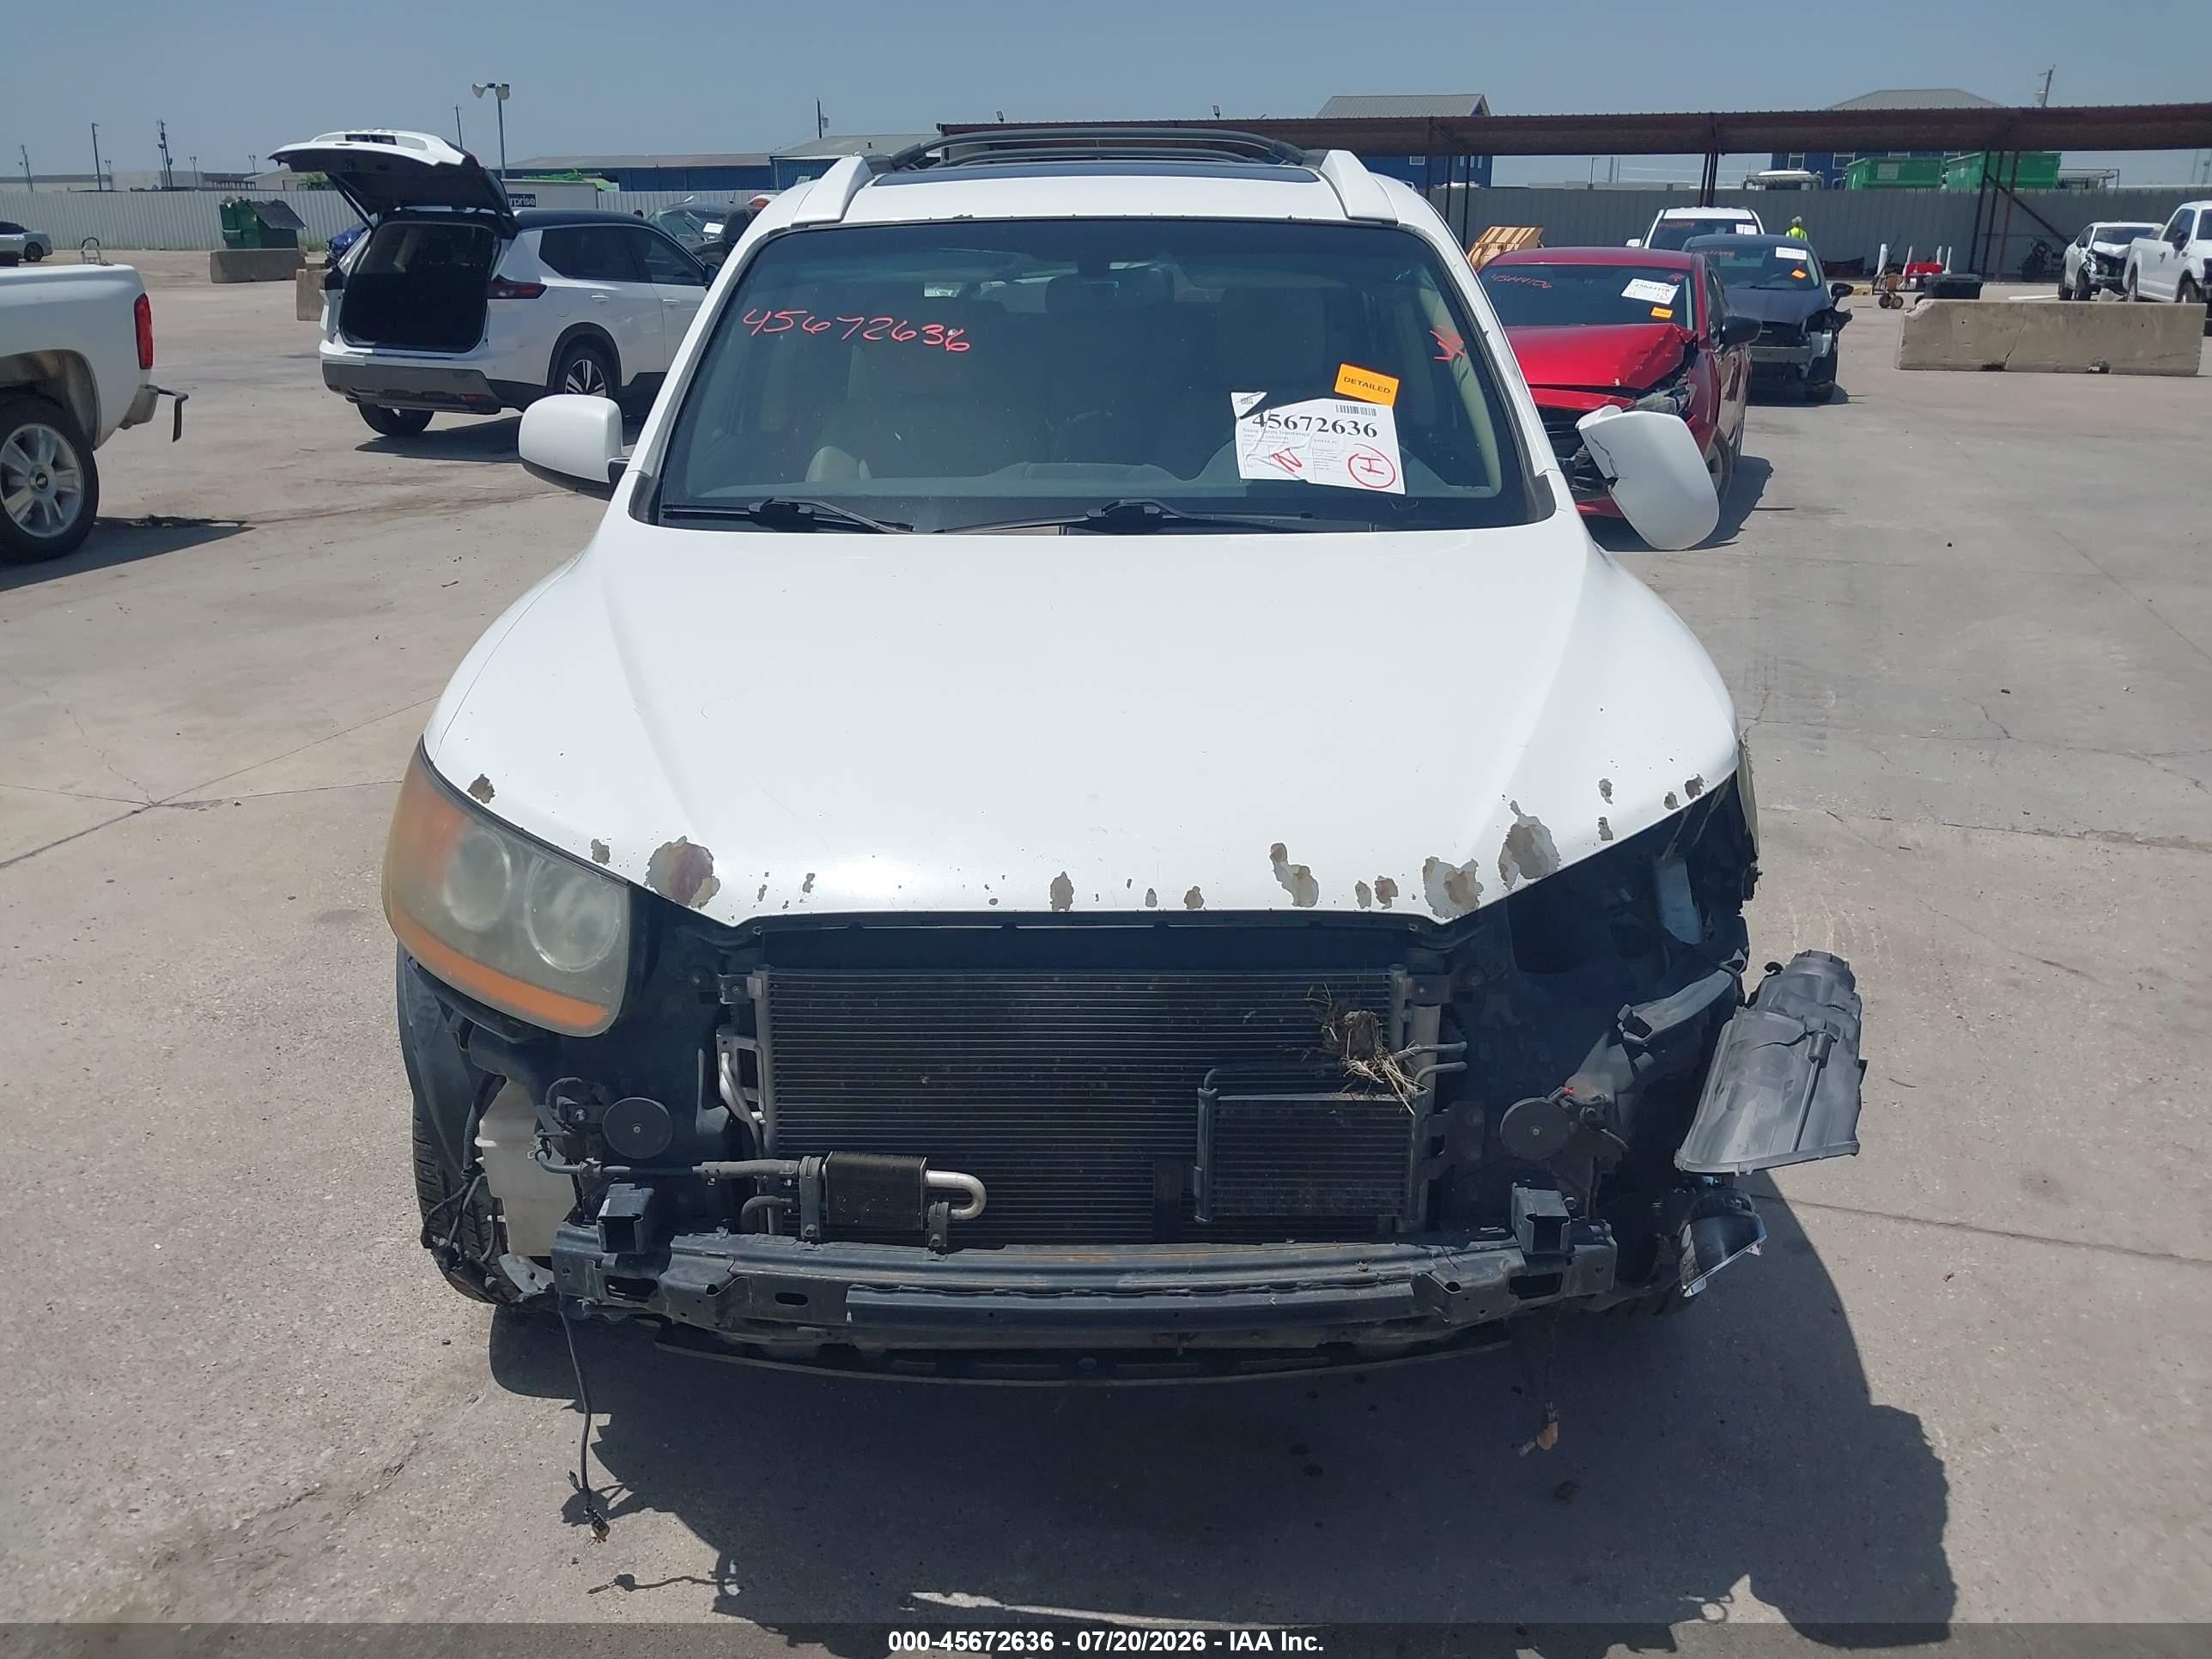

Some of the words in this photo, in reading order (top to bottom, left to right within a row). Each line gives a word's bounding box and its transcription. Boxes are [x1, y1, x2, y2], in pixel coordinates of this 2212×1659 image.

[508, 194, 536, 206] rprise
[742, 308, 971, 351] 45672636
[1343, 375, 1391, 394] DETAILED
[1252, 413, 1377, 438] 45672636
